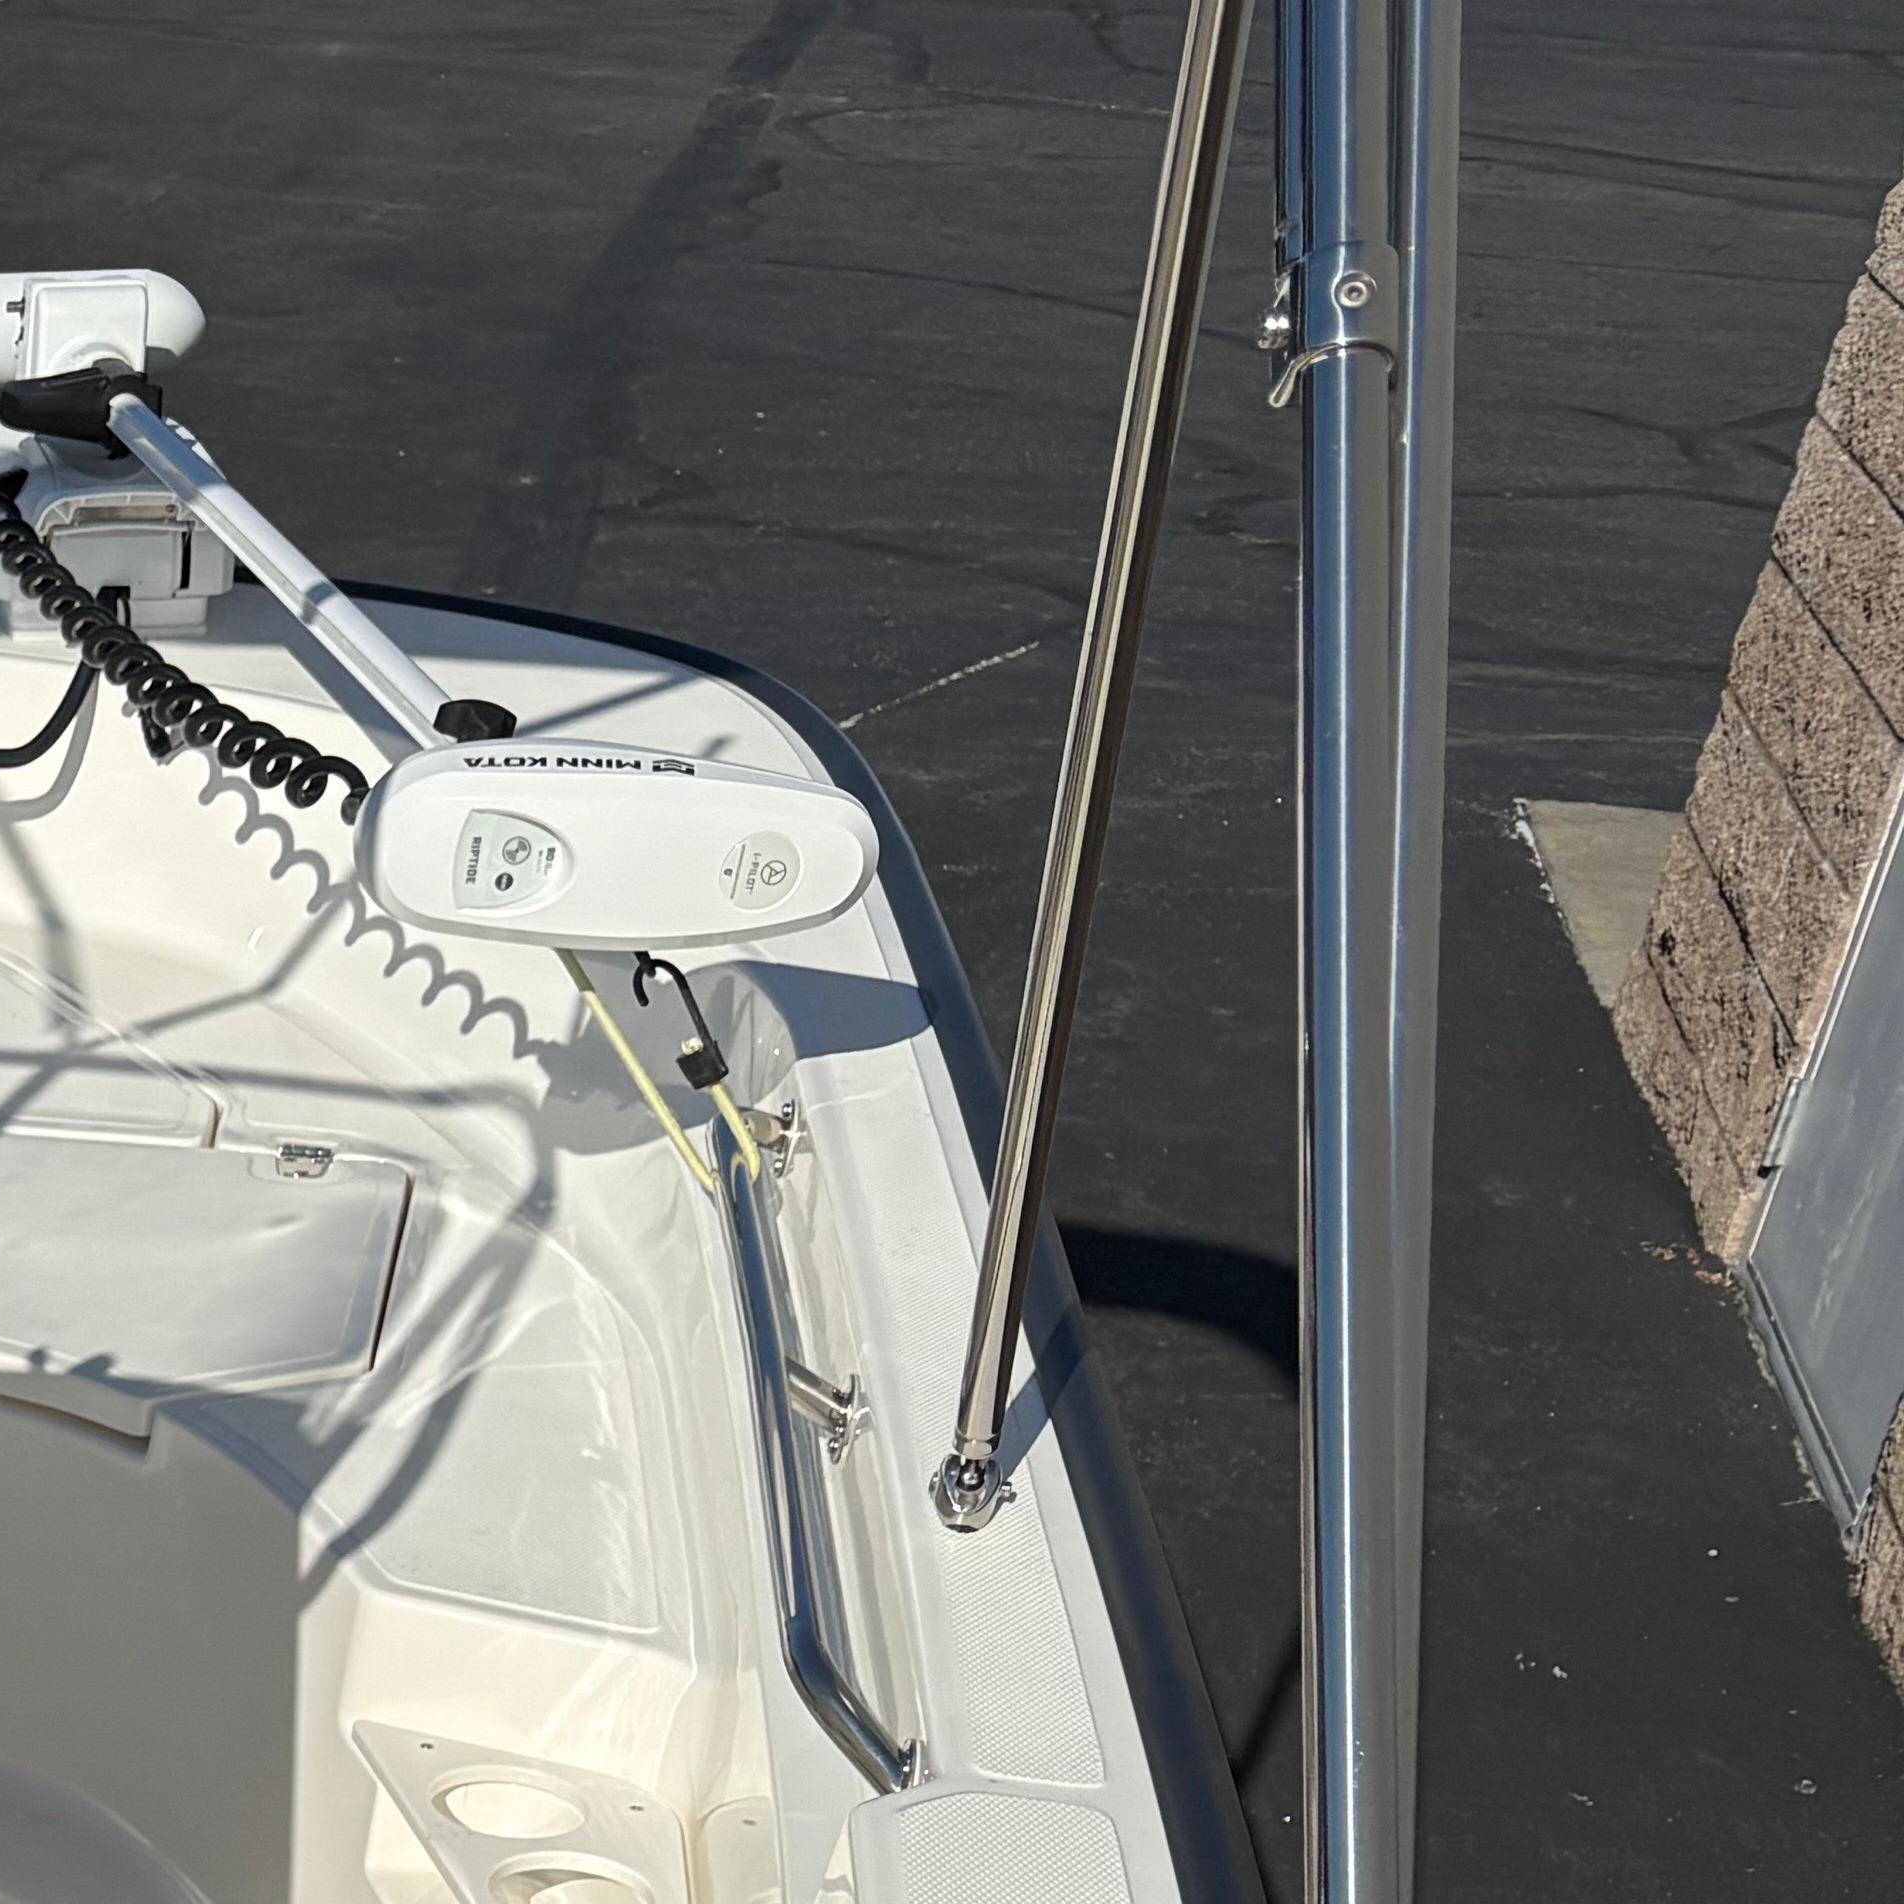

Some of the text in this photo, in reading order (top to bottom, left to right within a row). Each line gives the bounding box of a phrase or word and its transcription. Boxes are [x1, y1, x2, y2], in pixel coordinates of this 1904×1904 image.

[463, 756, 642, 770] MINN KOTA
[464, 836, 482, 885] RIPTIDE
